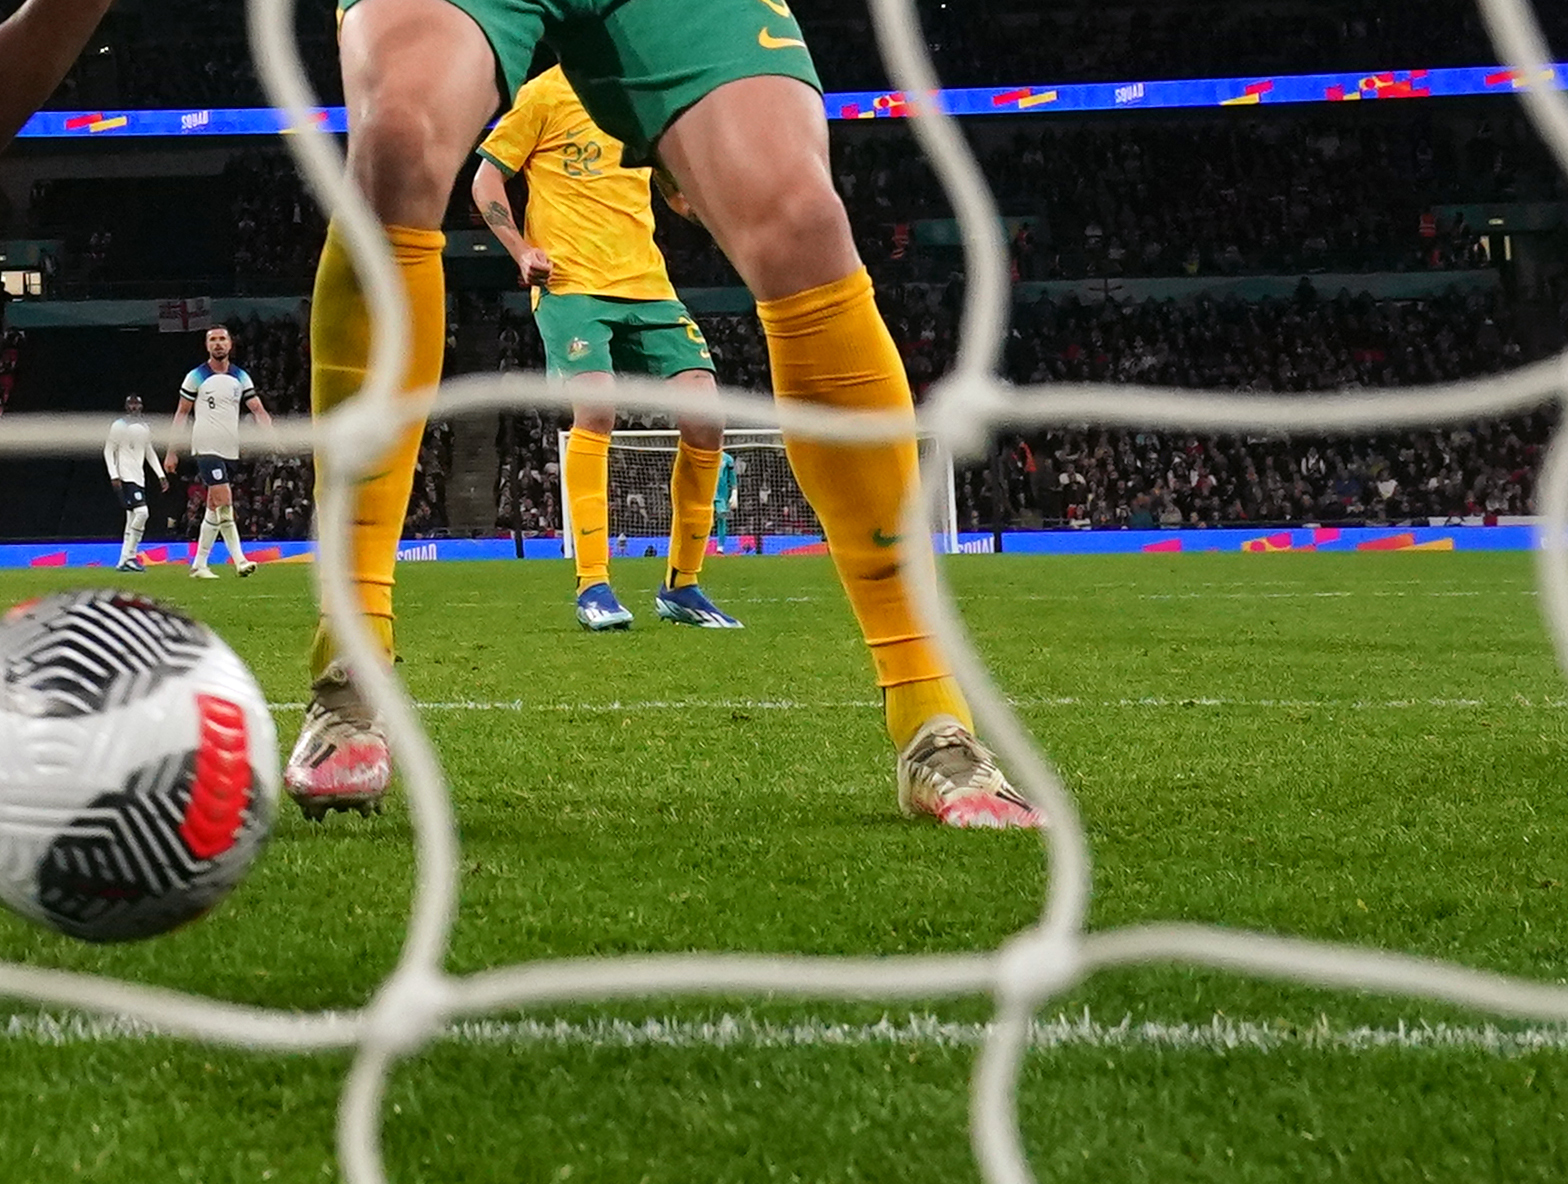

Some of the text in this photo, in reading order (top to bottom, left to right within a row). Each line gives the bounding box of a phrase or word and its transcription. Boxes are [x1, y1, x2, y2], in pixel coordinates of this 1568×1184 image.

[1115, 83, 1144, 103] SQUAD
[181, 110, 209, 129] SQUAD
[563, 141, 603, 177] 22
[207, 396, 216, 410] 8
